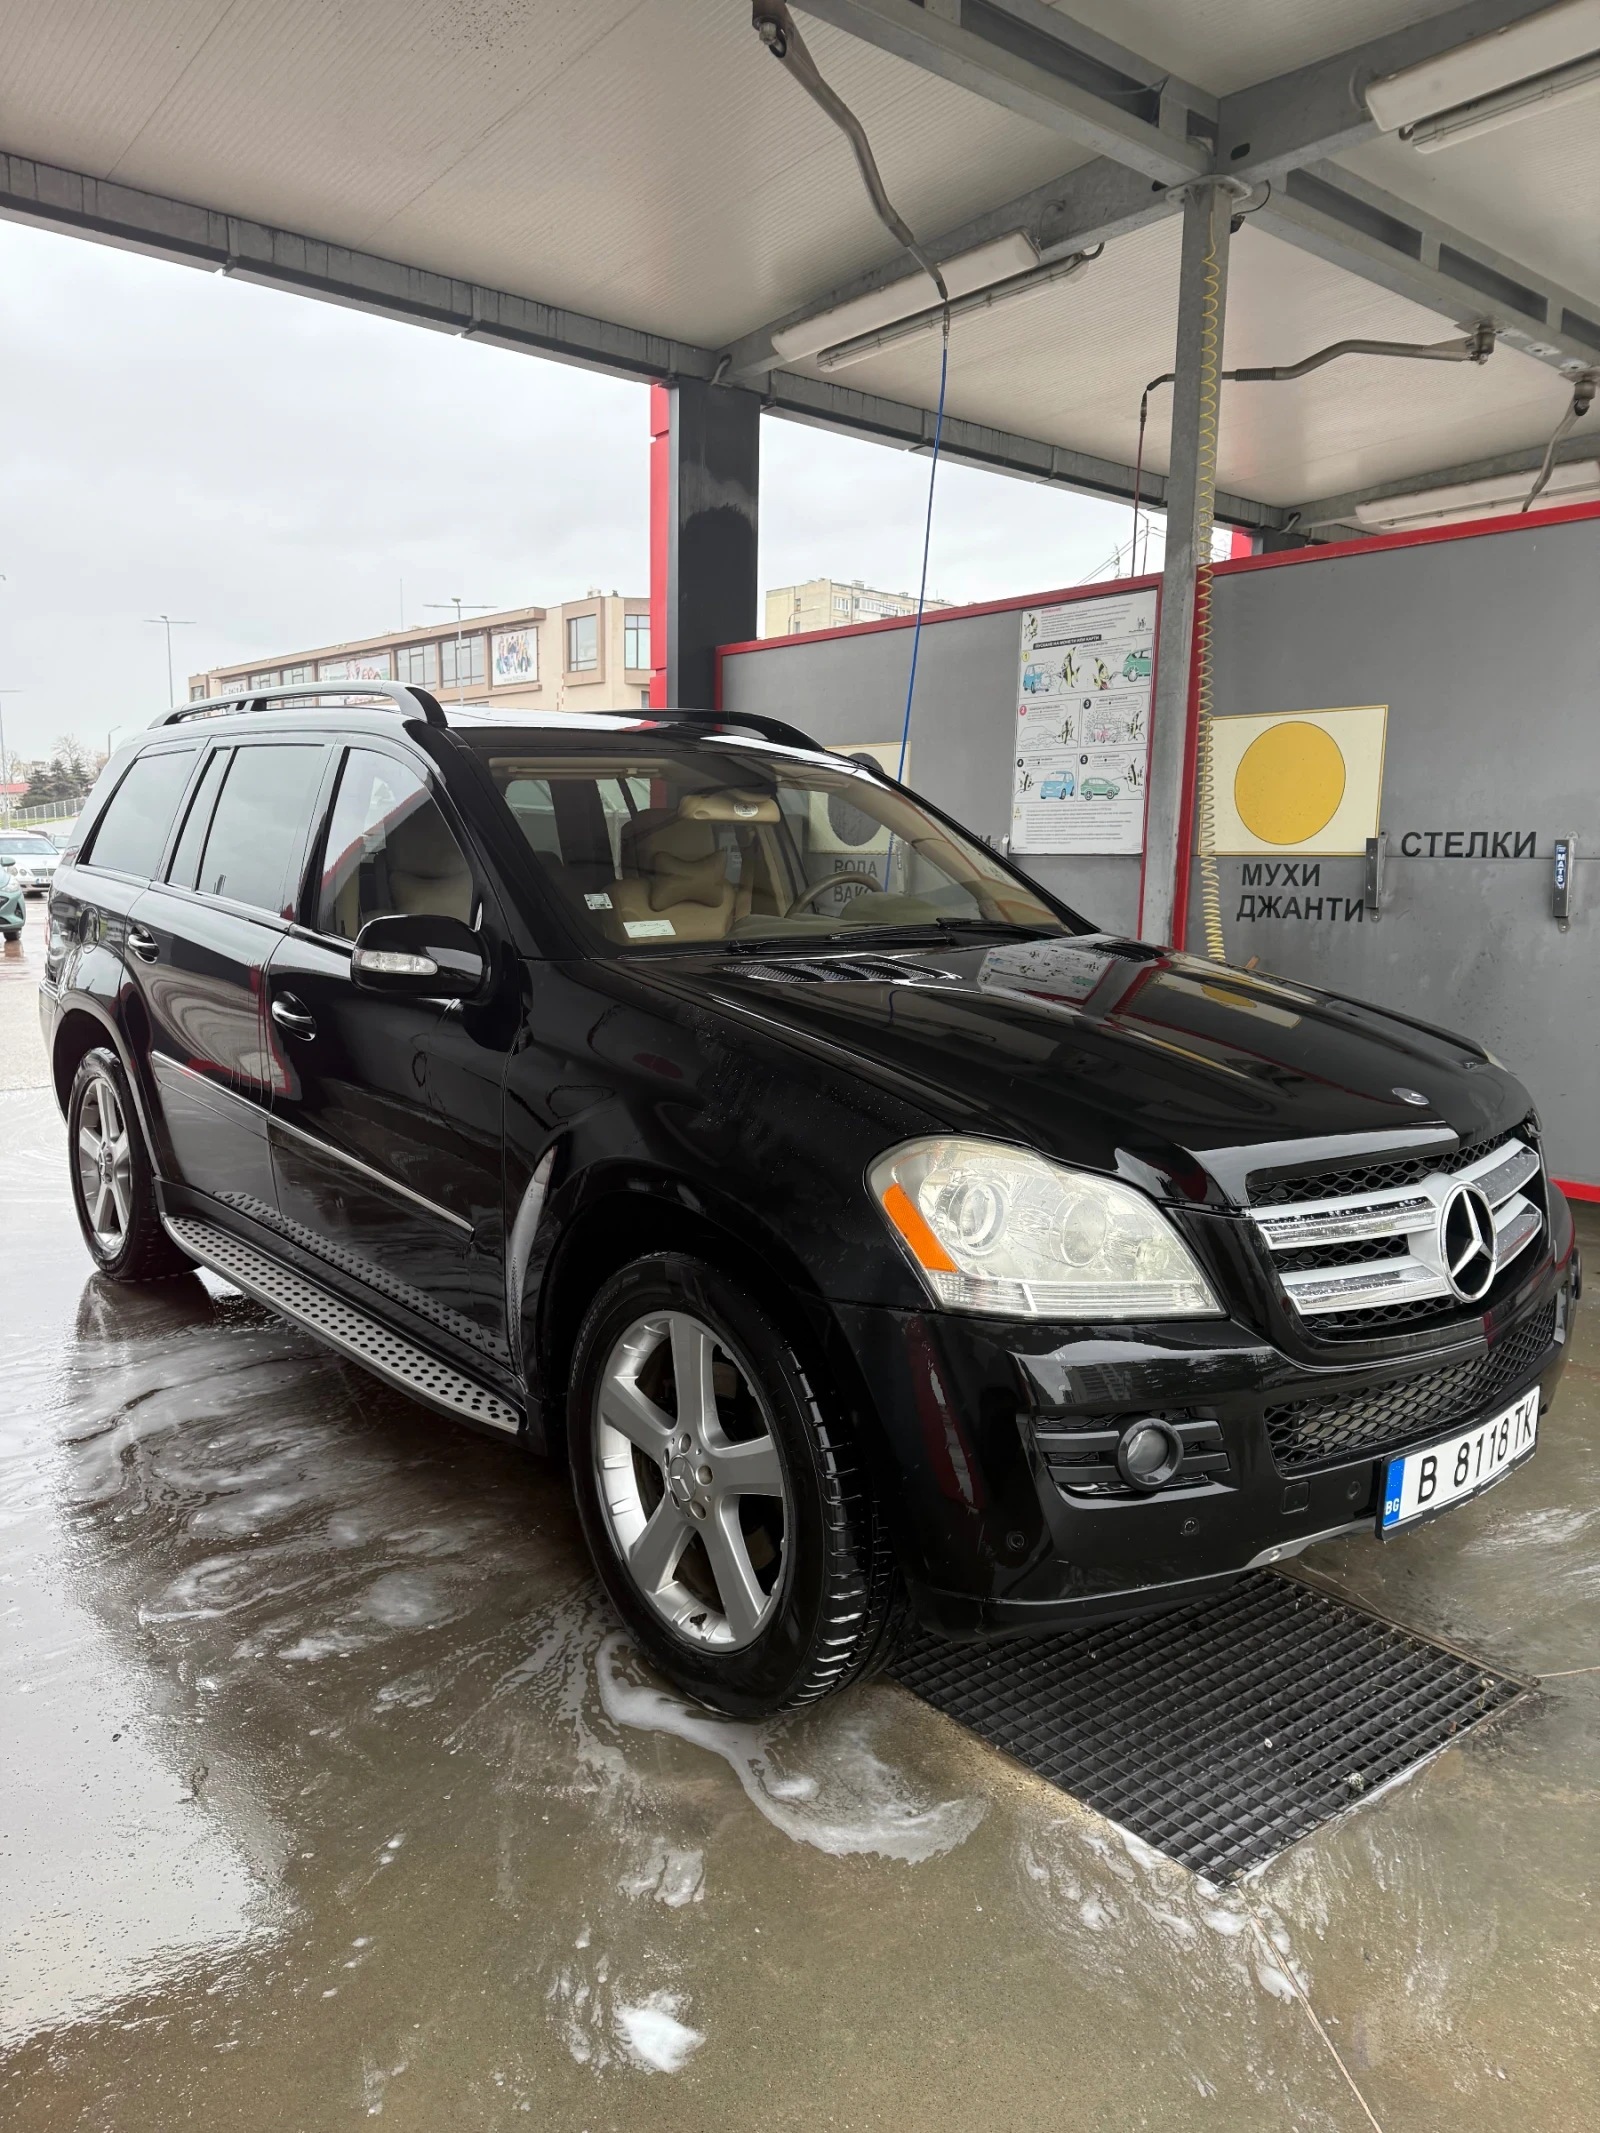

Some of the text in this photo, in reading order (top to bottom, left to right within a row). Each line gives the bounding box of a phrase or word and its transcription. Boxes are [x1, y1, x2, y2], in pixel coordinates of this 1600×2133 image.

[1401, 831, 1537, 859] СТЕЛКИ
[1241, 863, 1320, 887] МУХИ
[1557, 853, 1566, 882] MATS
[1236, 895, 1364, 922] ДЖАНТИ
[1417, 1395, 1536, 1505] B 8118 TK
[1385, 1497, 1400, 1516] BG
